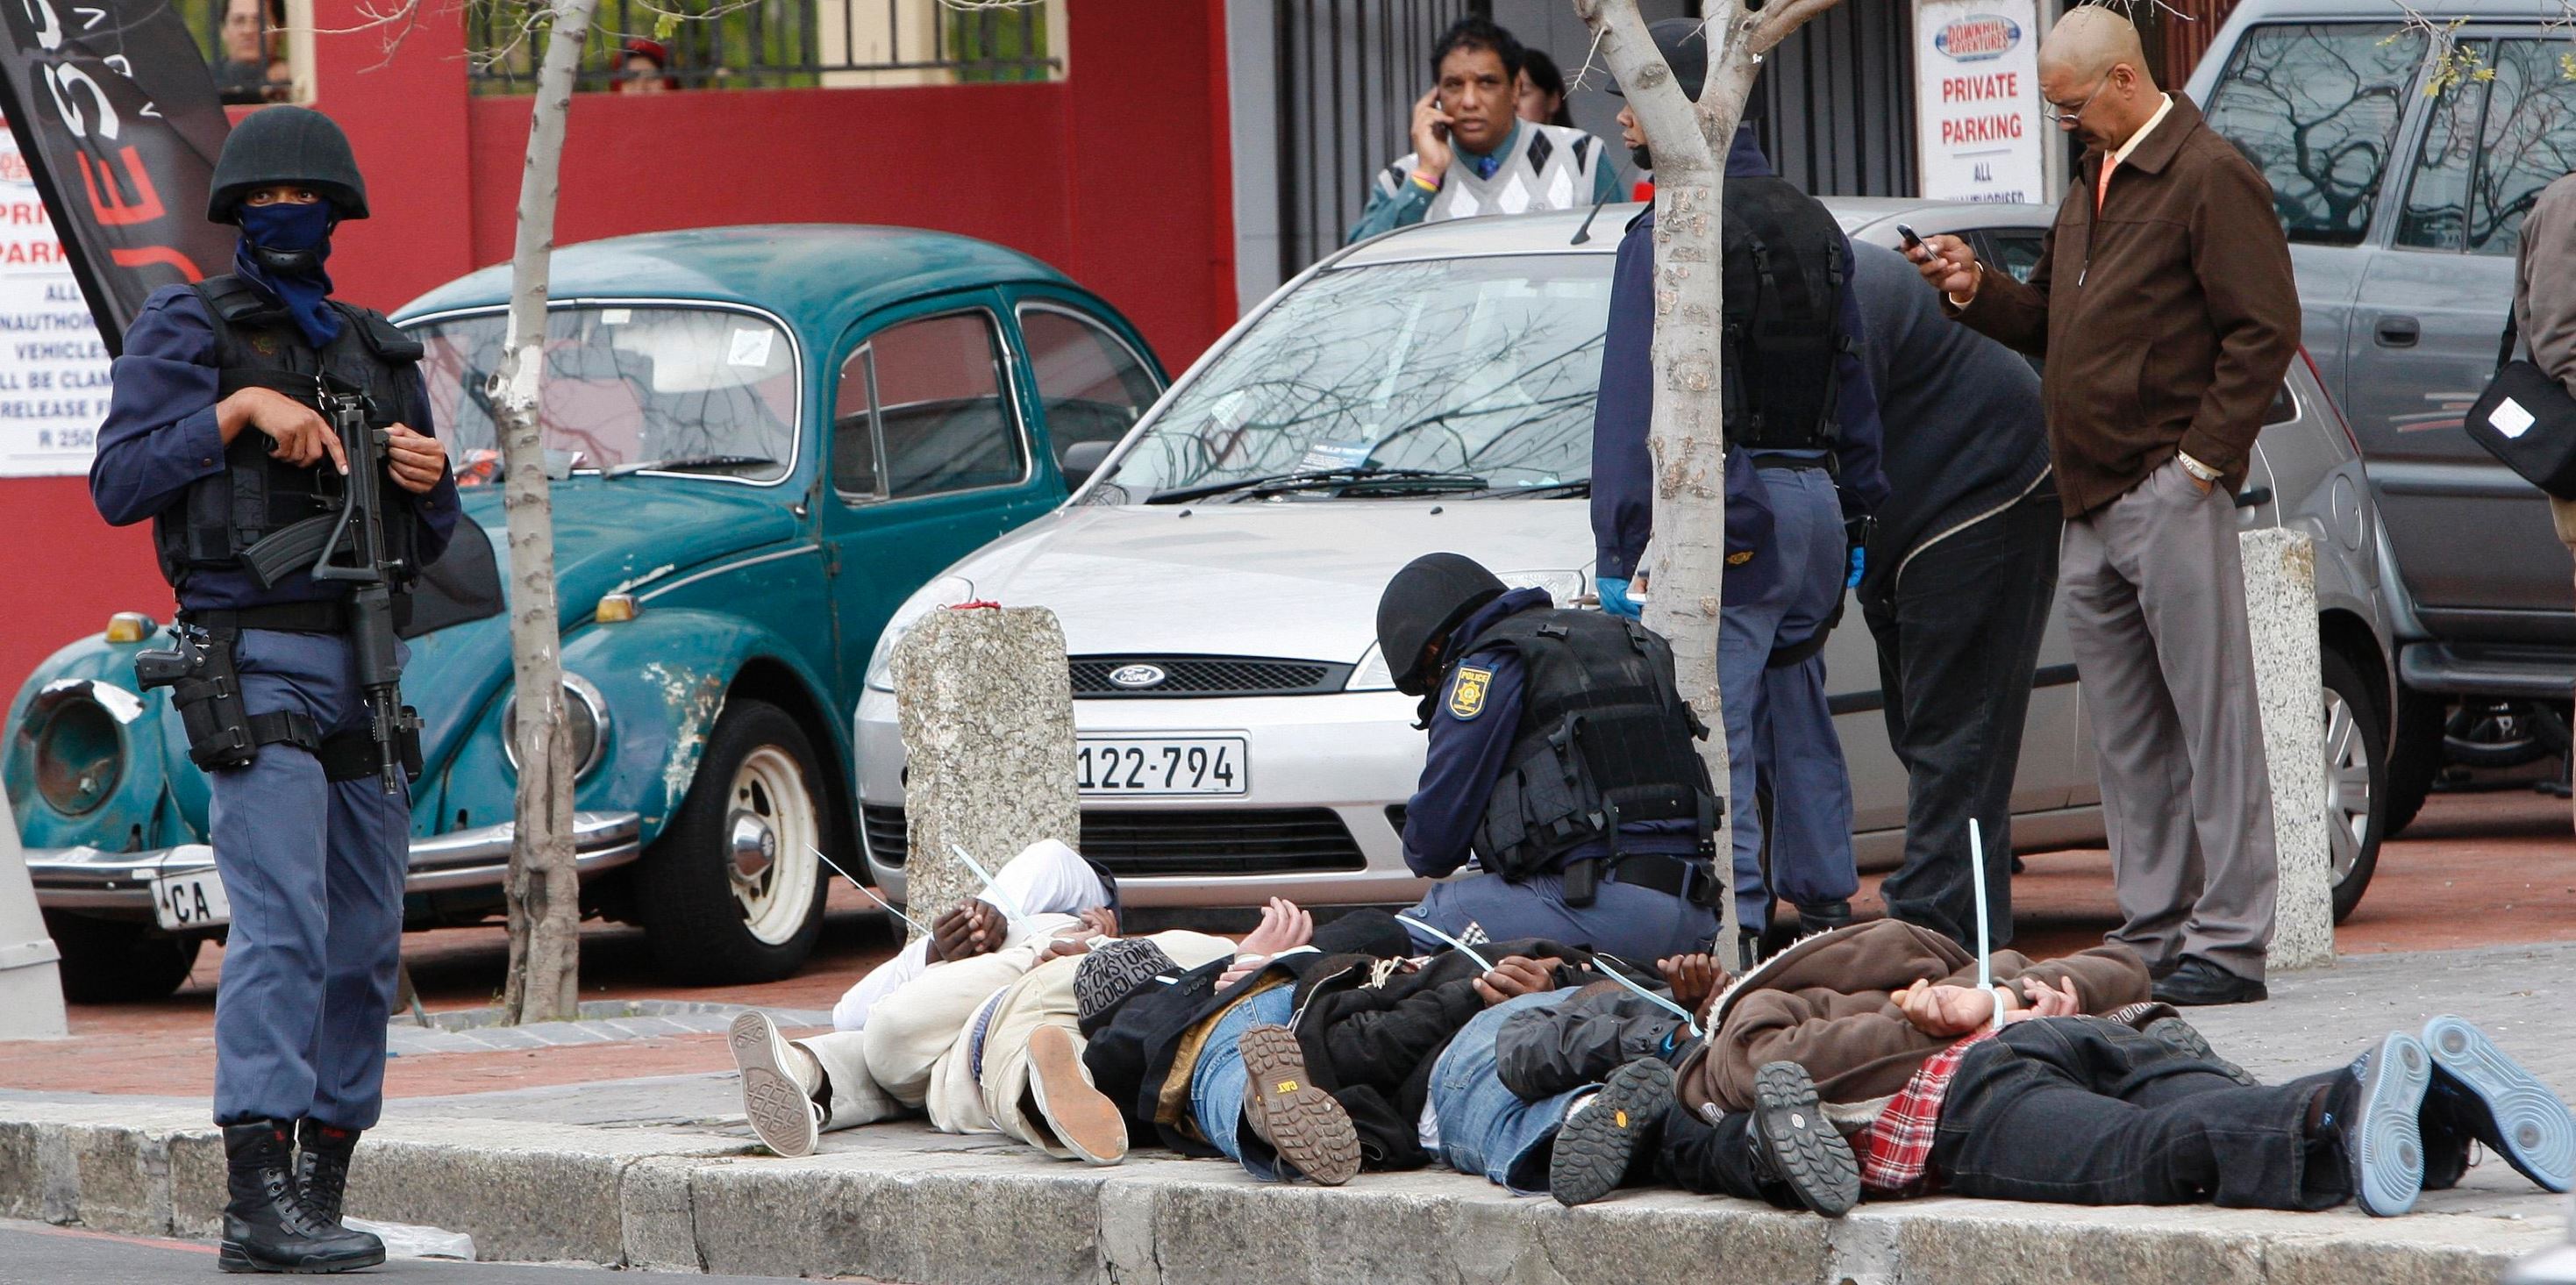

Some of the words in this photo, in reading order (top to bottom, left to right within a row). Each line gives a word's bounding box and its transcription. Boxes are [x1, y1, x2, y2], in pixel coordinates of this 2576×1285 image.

[1946, 21, 2006, 44] DOWNHILL
[1949, 33, 2009, 55] ADVENTURES
[1943, 72, 2018, 103] PRIVATE
[1942, 113, 2023, 145] PARKING
[1974, 161, 1992, 182] ALL
[45, 285, 79, 301] ALL
[15, 340, 109, 360] VEHICLE
[29, 371, 52, 388] BE
[1, 399, 87, 417] RELEASE
[39, 429, 51, 446] R
[59, 428, 94, 446] 250
[1119, 667, 1151, 682] Ford
[1459, 671, 1488, 683] POLICE
[1078, 746, 1233, 789] 122-794
[172, 882, 211, 923] CA
[1277, 1081, 1298, 1094] CAT
